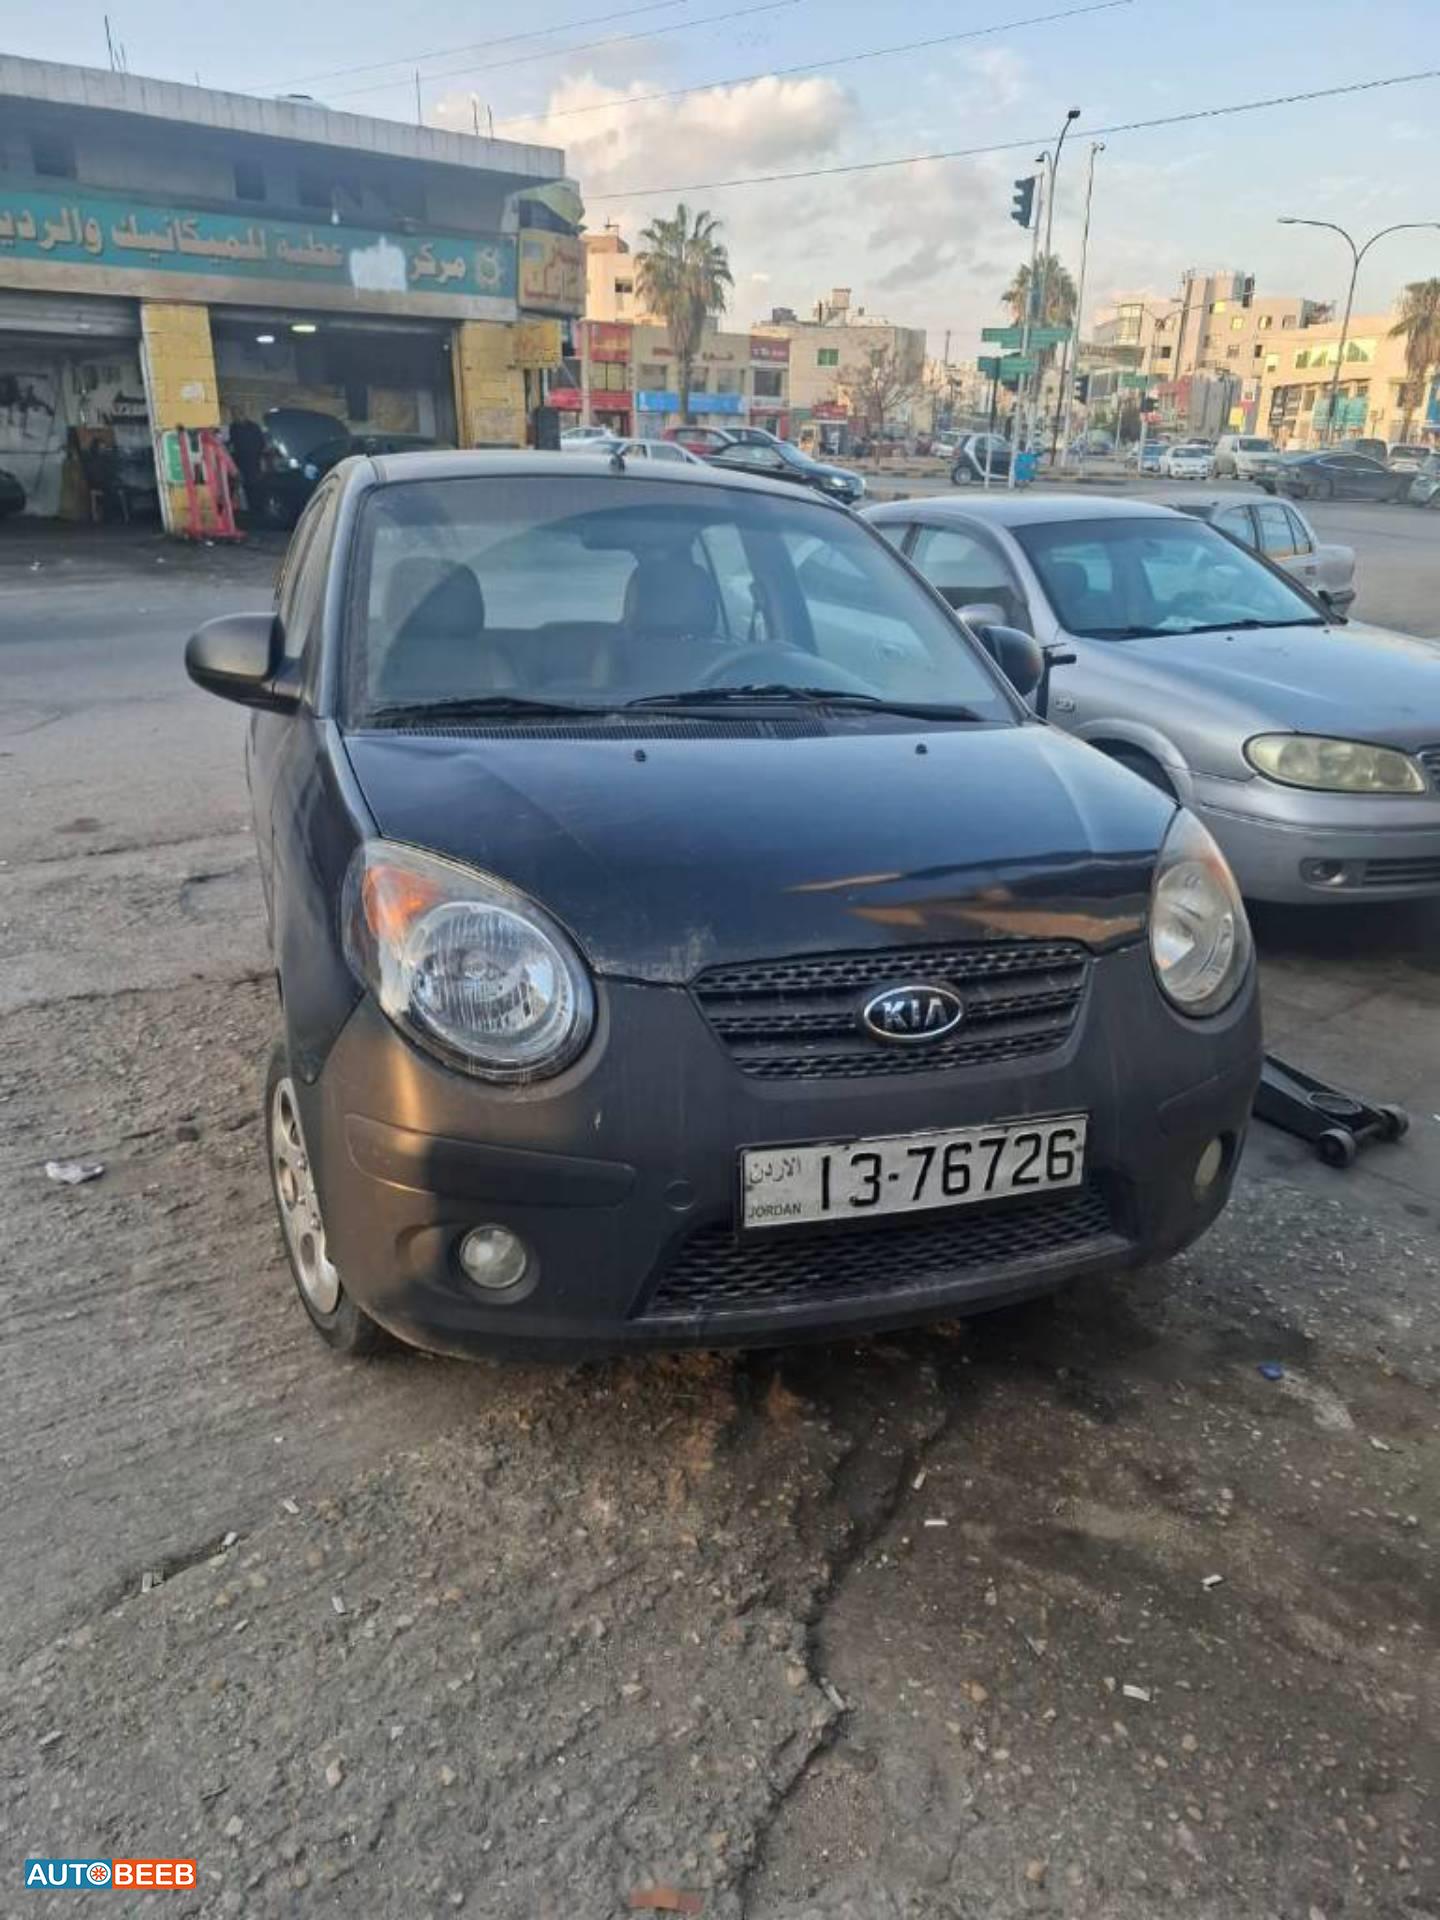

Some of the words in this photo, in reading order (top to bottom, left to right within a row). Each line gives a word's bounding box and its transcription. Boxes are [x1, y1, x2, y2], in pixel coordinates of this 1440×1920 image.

[0, 205, 103, 254] والردي
[111, 214, 267, 264] للميكانيك
[408, 242, 466, 283] مركز
[882, 997, 947, 1029] KIA
[821, 1128, 1077, 1210] 13-76726
[750, 1202, 801, 1218] JORDAN
